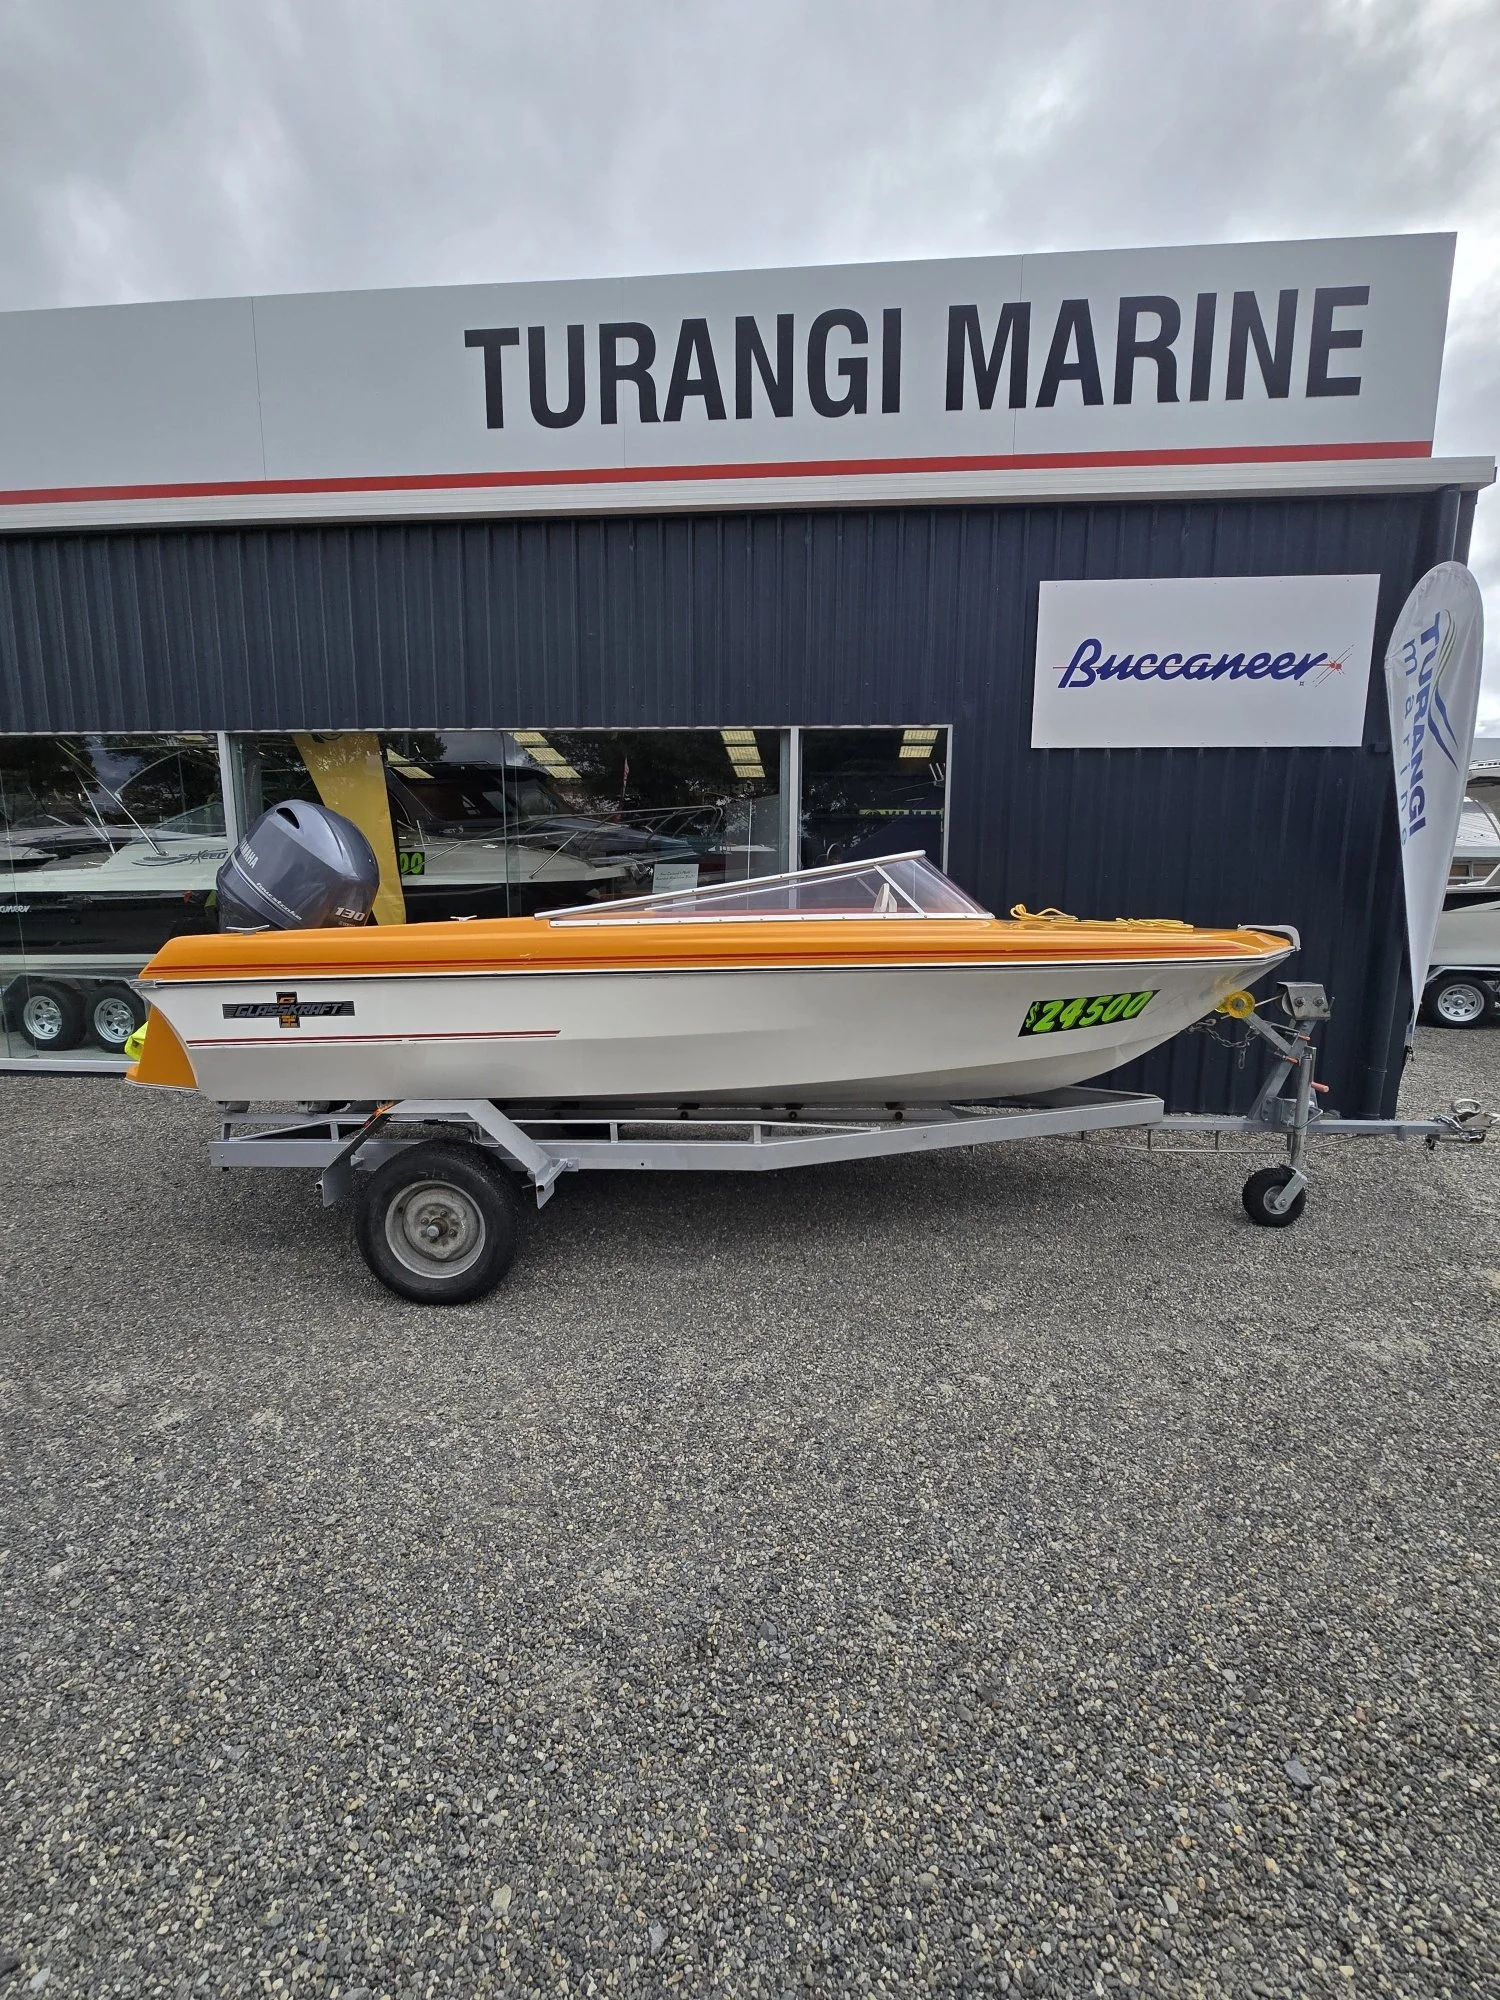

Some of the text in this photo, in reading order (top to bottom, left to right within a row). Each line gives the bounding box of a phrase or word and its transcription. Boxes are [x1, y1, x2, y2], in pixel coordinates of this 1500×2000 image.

[464, 286, 1370, 429] TURANGI MARINE
[1057, 638, 1329, 688] Buccaneer
[1400, 638, 1418, 846] marine
[1409, 611, 1441, 837] TURANGI
[335, 907, 366, 922] 130
[234, 1003, 342, 1017] GLASSKRAFT
[1025, 991, 1154, 1032] $24500
